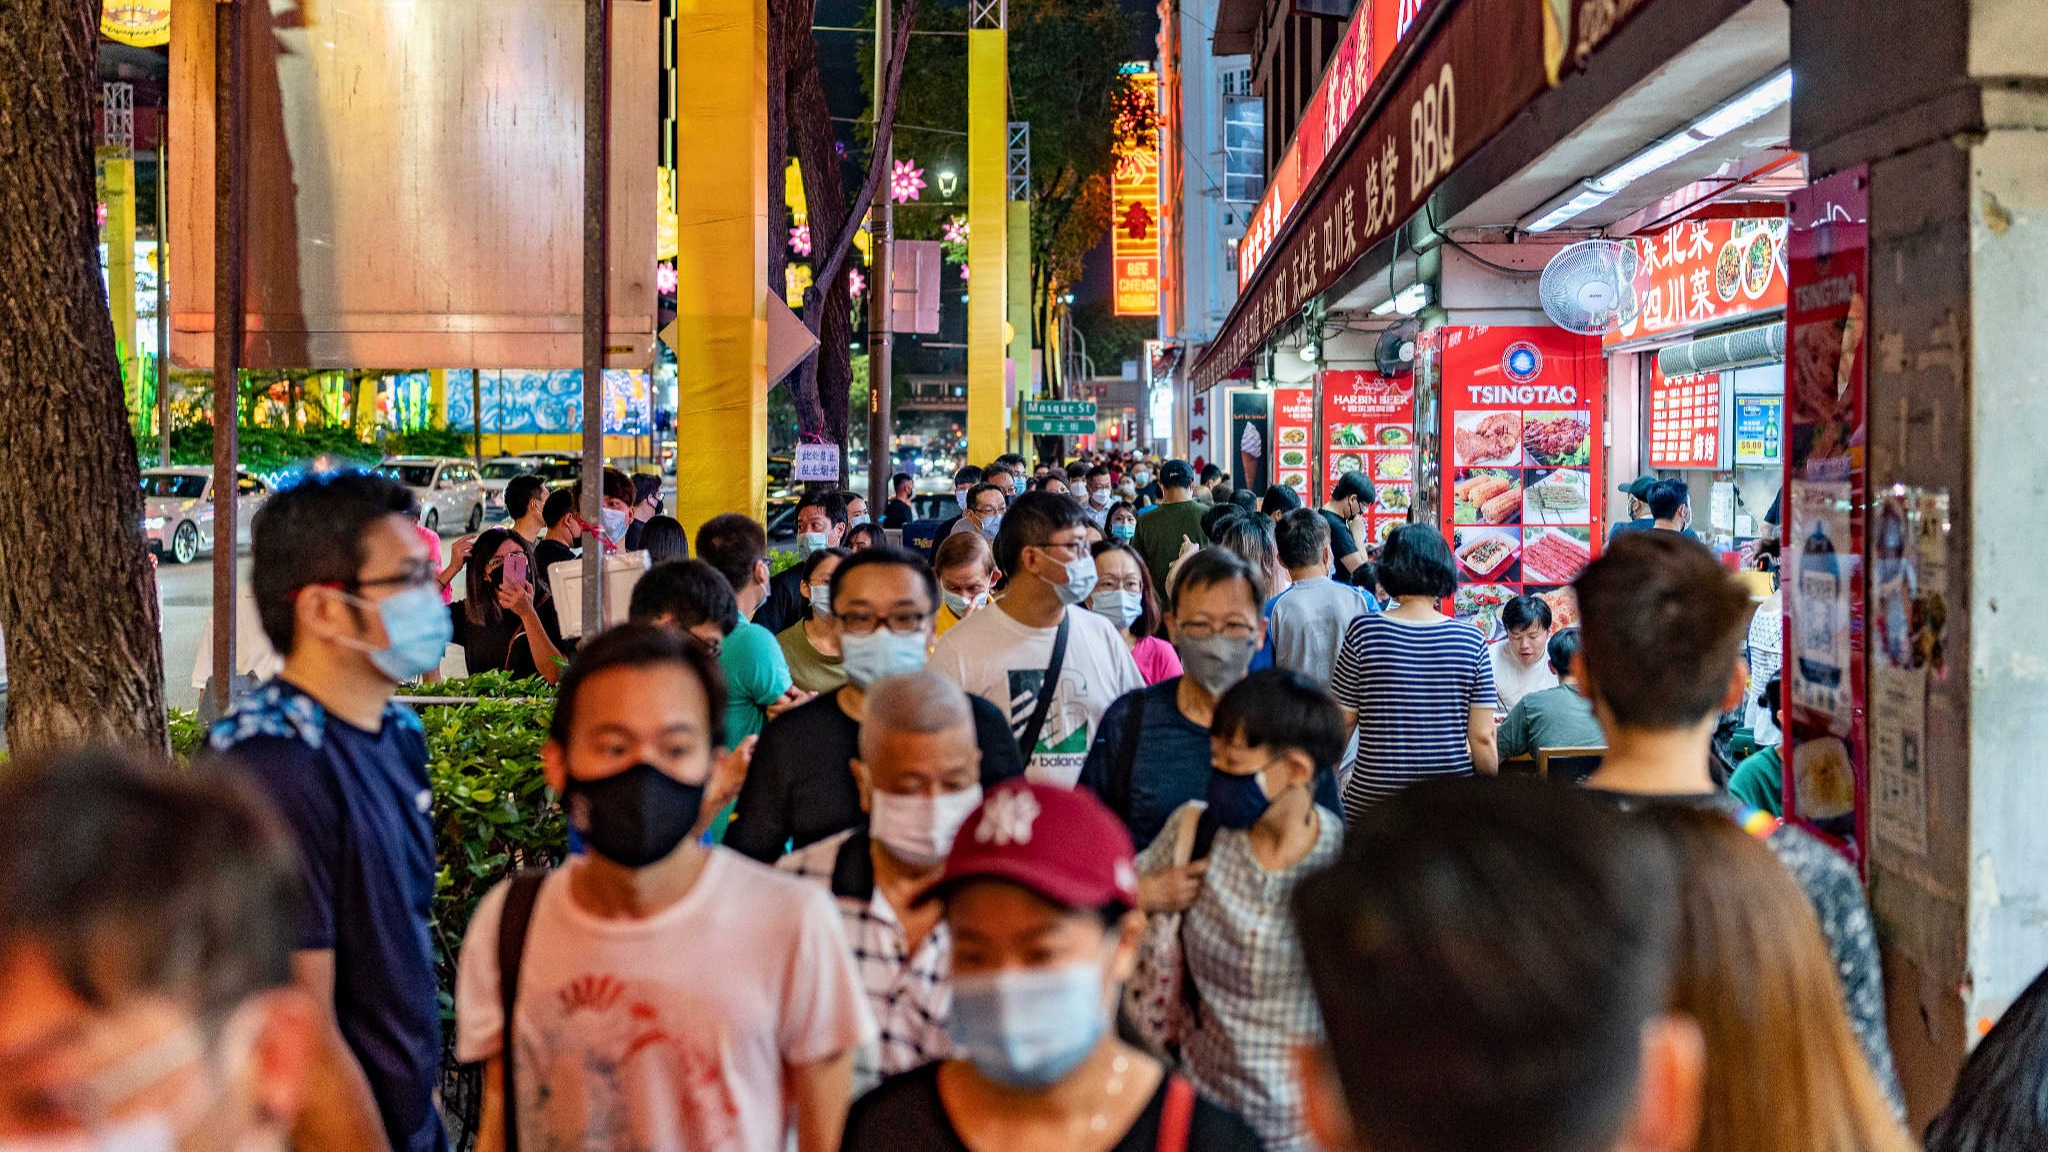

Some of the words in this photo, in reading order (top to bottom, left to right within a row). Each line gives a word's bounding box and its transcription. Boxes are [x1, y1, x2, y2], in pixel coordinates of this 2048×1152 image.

[1291, 227, 1318, 310] 东北菜
[1323, 184, 1356, 274] 四川菜
[1364, 134, 1399, 238] 烧烤
[1410, 62, 1456, 202] BBQ
[1640, 220, 1714, 276] 东北菜
[1642, 266, 1716, 332] 四川菜
[1333, 394, 1377, 404] HARBIN
[1380, 394, 1408, 404] BEER
[1467, 384, 1577, 404] TSINGTAO
[1028, 402, 1074, 414] Mosque
[1078, 402, 1090, 413] St
[1040, 756, 1085, 767] balanc
